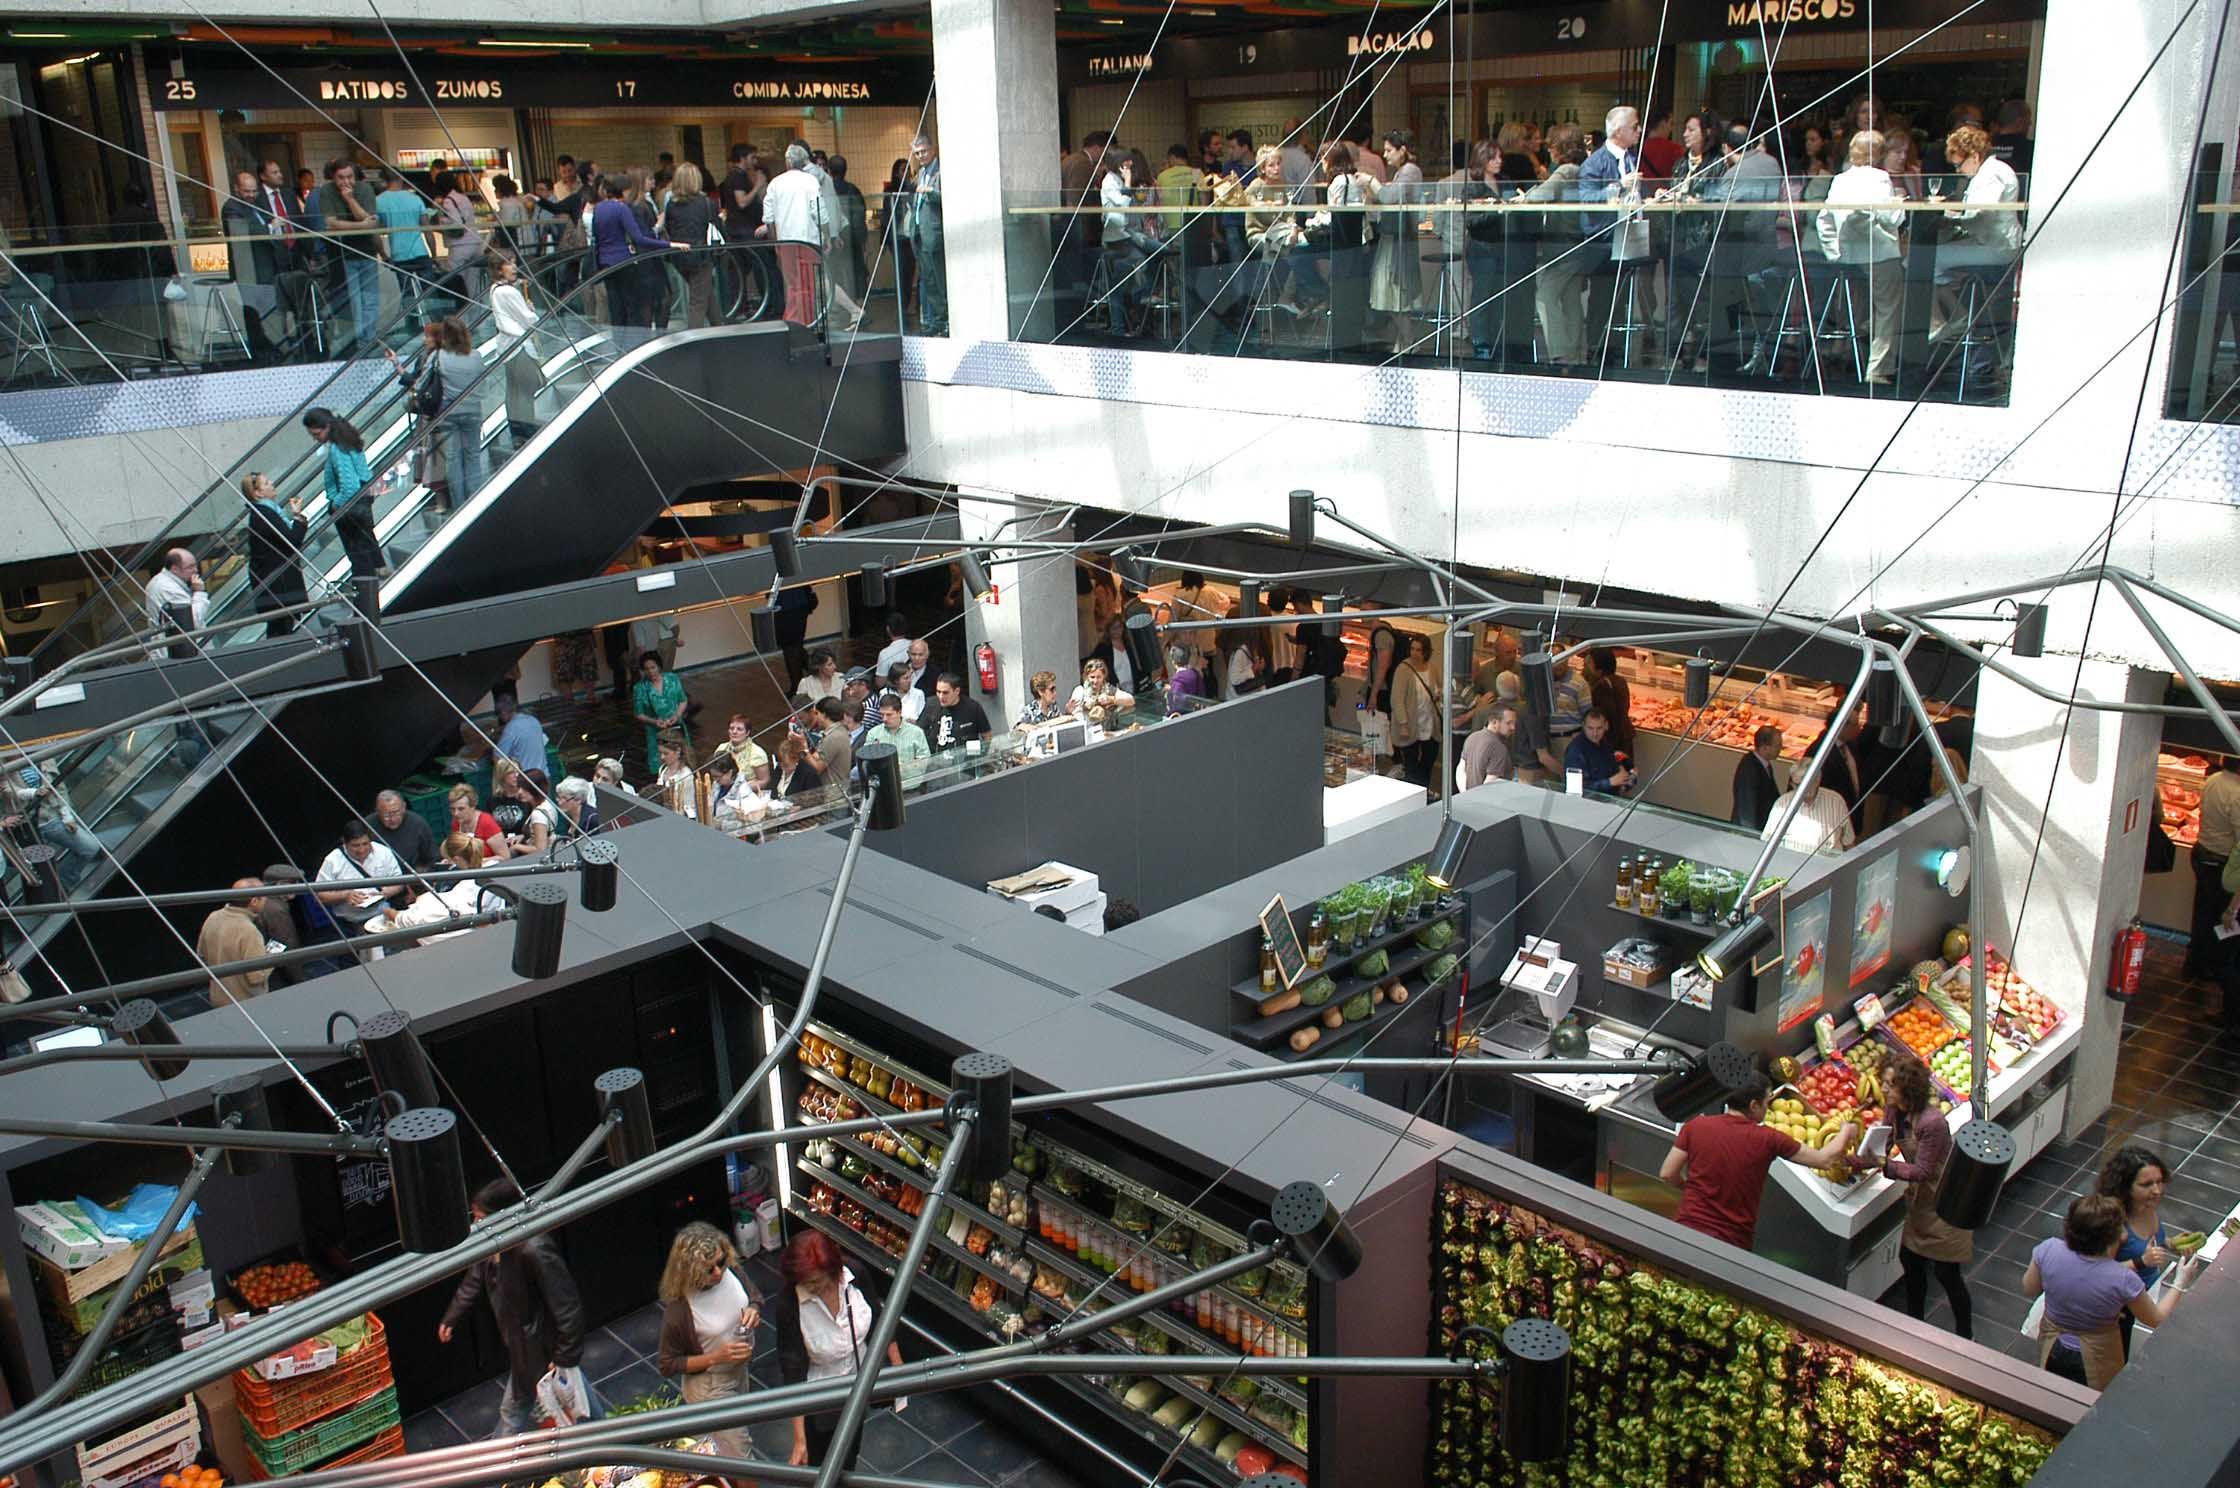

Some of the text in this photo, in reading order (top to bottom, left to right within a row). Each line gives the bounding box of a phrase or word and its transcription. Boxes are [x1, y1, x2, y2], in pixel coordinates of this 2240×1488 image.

[1727, 0, 1856, 26] MARISCOS
[1557, 17, 1586, 39] 20
[1348, 30, 1434, 56] BACALAO
[1240, 46, 1257, 65] 19
[1089, 55, 1153, 77] ITALIANO
[166, 80, 197, 100] 25
[320, 80, 503, 100] BATIDOS ZUMOS
[616, 81, 636, 97] 17
[733, 82, 870, 99] COMIDA JAPONESA
